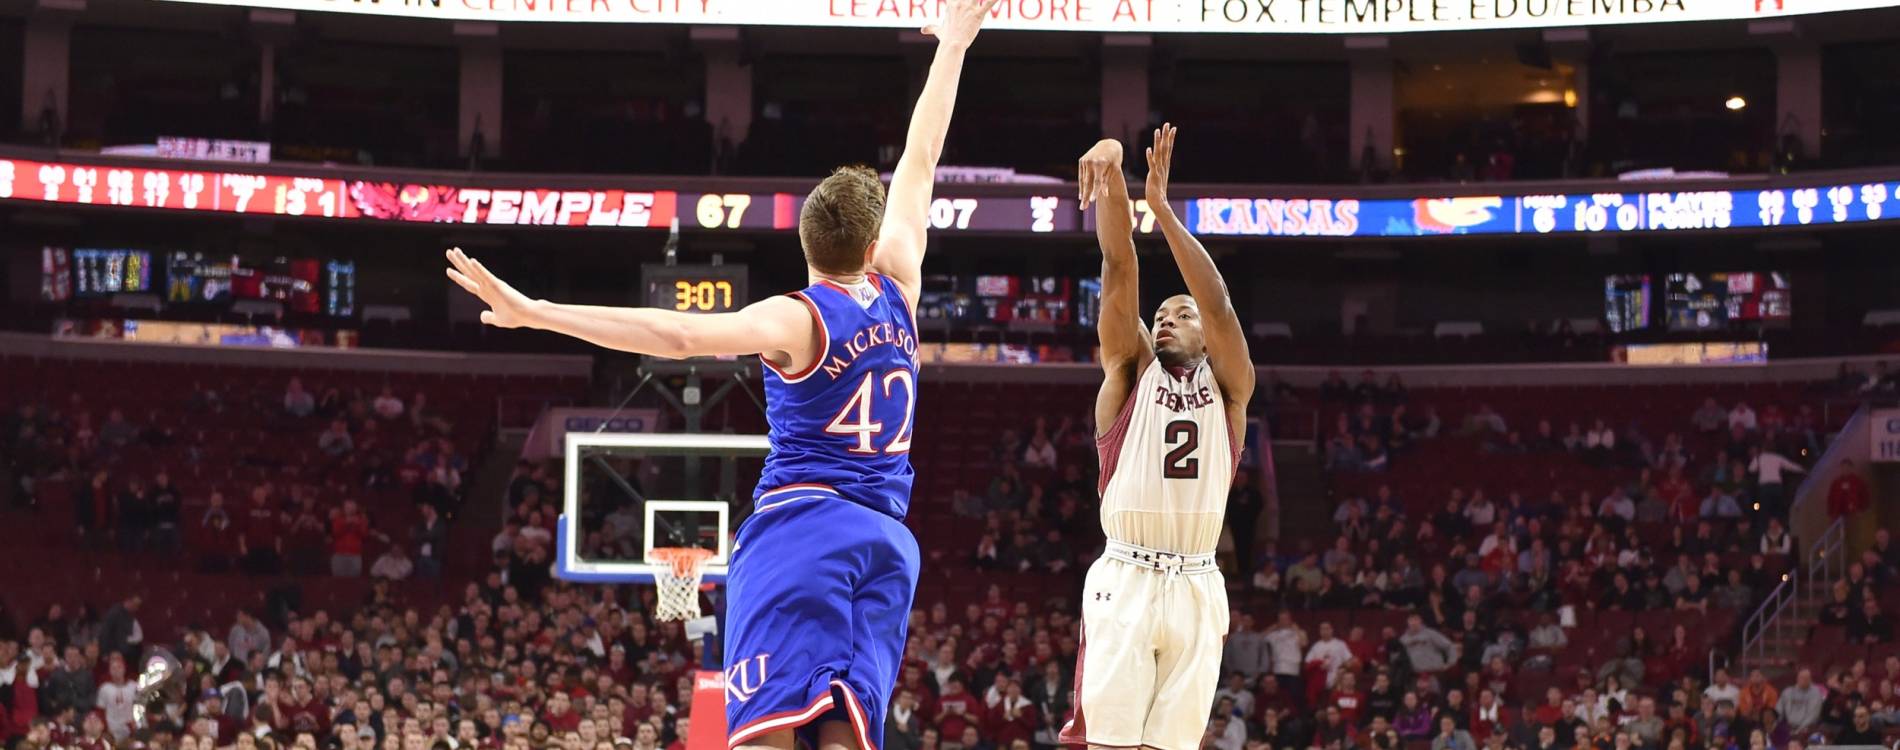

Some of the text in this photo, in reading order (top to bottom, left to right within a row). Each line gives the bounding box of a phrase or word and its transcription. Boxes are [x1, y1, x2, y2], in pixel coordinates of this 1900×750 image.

[830, 0, 947, 20] LEAR
[458, 188, 654, 227] TEMPLE
[697, 193, 751, 229] 67
[1196, 198, 1360, 236] KANSAS
[675, 281, 733, 311] 3:07
[822, 321, 921, 381] MICKESON
[824, 367, 915, 455] 42
[1155, 385, 1214, 413] TEMPLE
[1163, 419, 1199, 480] 2
[724, 653, 770, 705] KU
